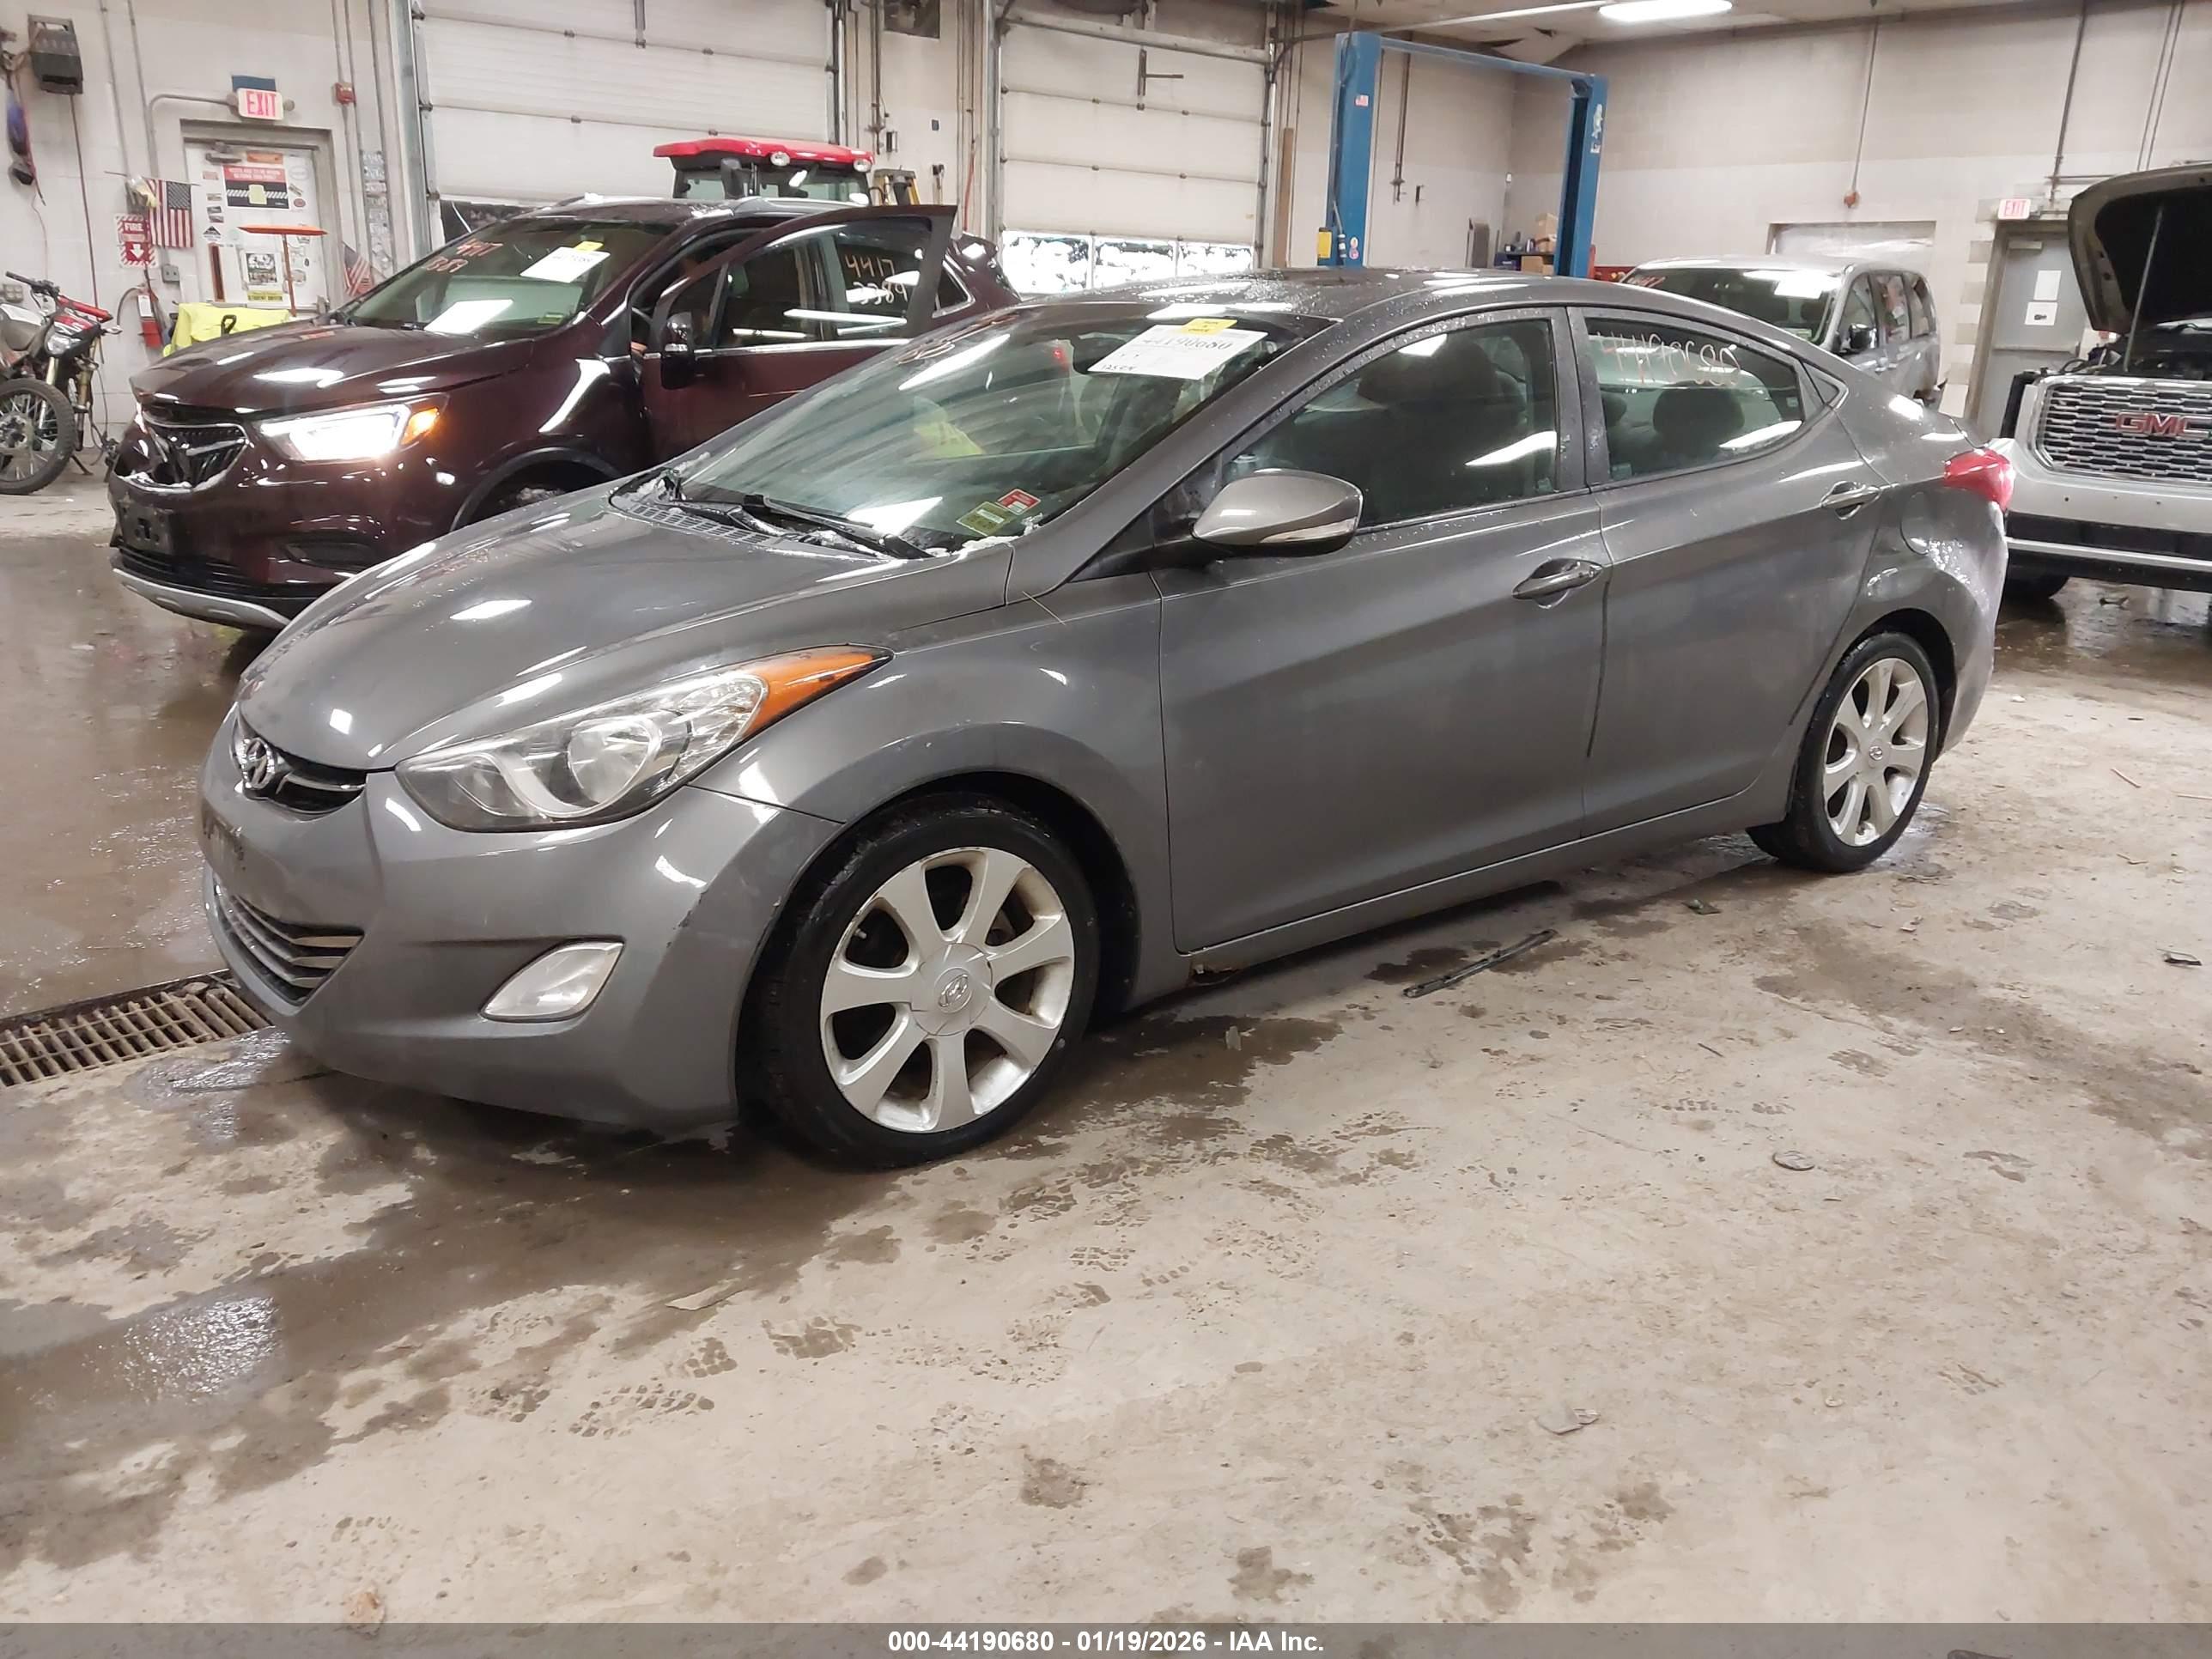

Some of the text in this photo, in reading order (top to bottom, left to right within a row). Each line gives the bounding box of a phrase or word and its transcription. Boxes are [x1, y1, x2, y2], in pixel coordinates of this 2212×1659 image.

[246, 90, 276, 116] EXIT
[845, 255, 895, 278] 4417
[2116, 412, 2212, 440] GMC
